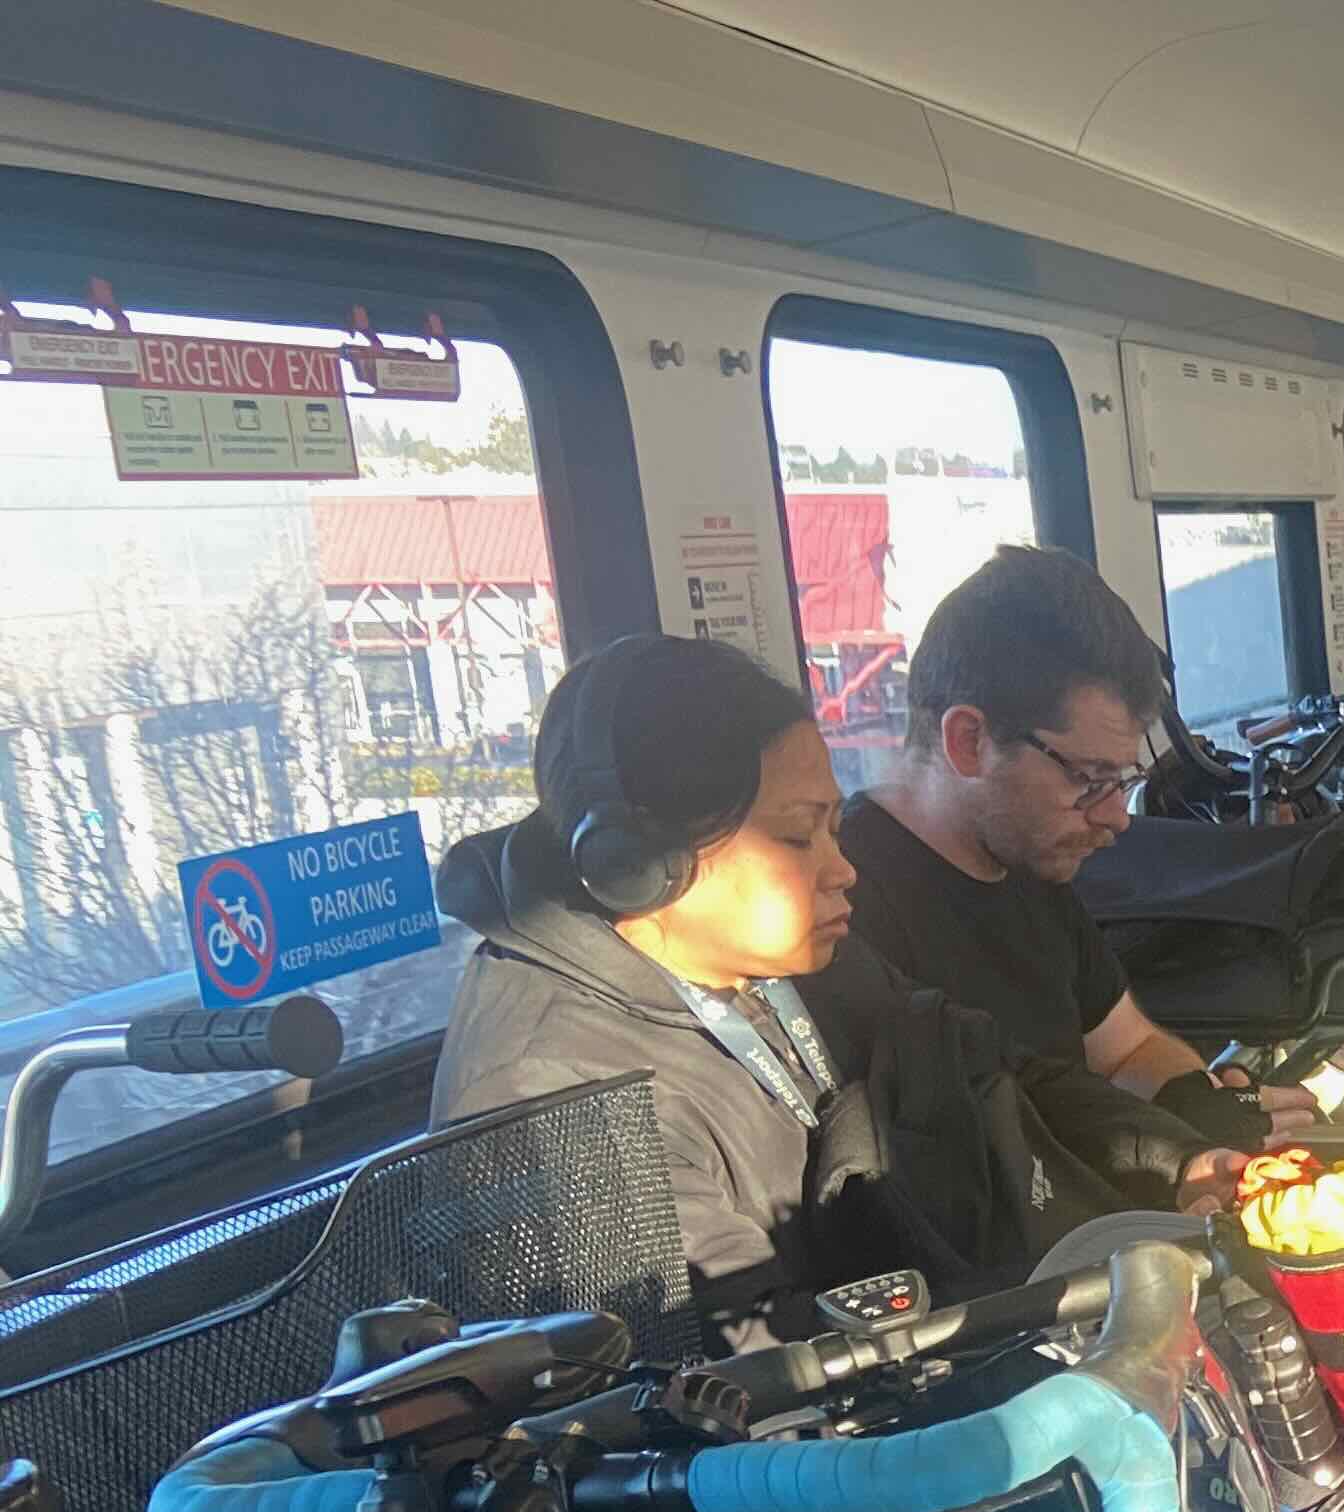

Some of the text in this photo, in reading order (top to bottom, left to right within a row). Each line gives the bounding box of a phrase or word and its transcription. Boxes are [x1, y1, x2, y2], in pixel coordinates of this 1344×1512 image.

[286, 351, 341, 392] EXIT
[288, 827, 403, 881] NO BICYCLE
[311, 877, 397, 927] PARKING
[279, 910, 437, 972] KEEP PASSAGEWAY CLEAR
[746, 1047, 799, 1108] Teleport
